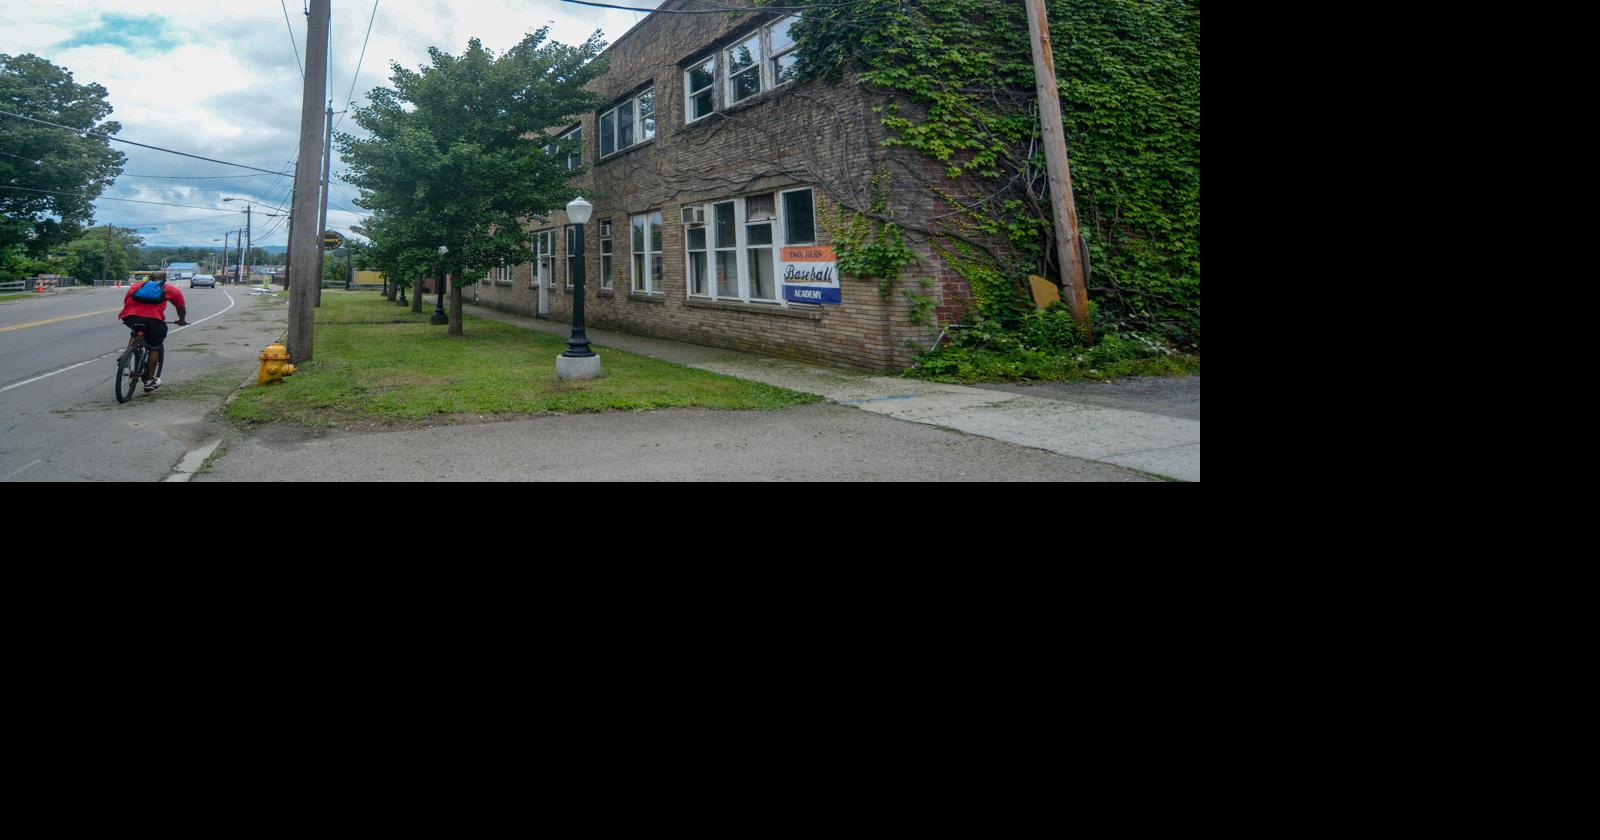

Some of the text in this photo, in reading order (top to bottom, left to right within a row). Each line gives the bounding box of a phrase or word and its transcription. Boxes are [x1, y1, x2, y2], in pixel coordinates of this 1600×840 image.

[790, 250, 803, 258] TWIN
[784, 264, 833, 282] Baseball
[794, 289, 822, 299] ACADEMY
